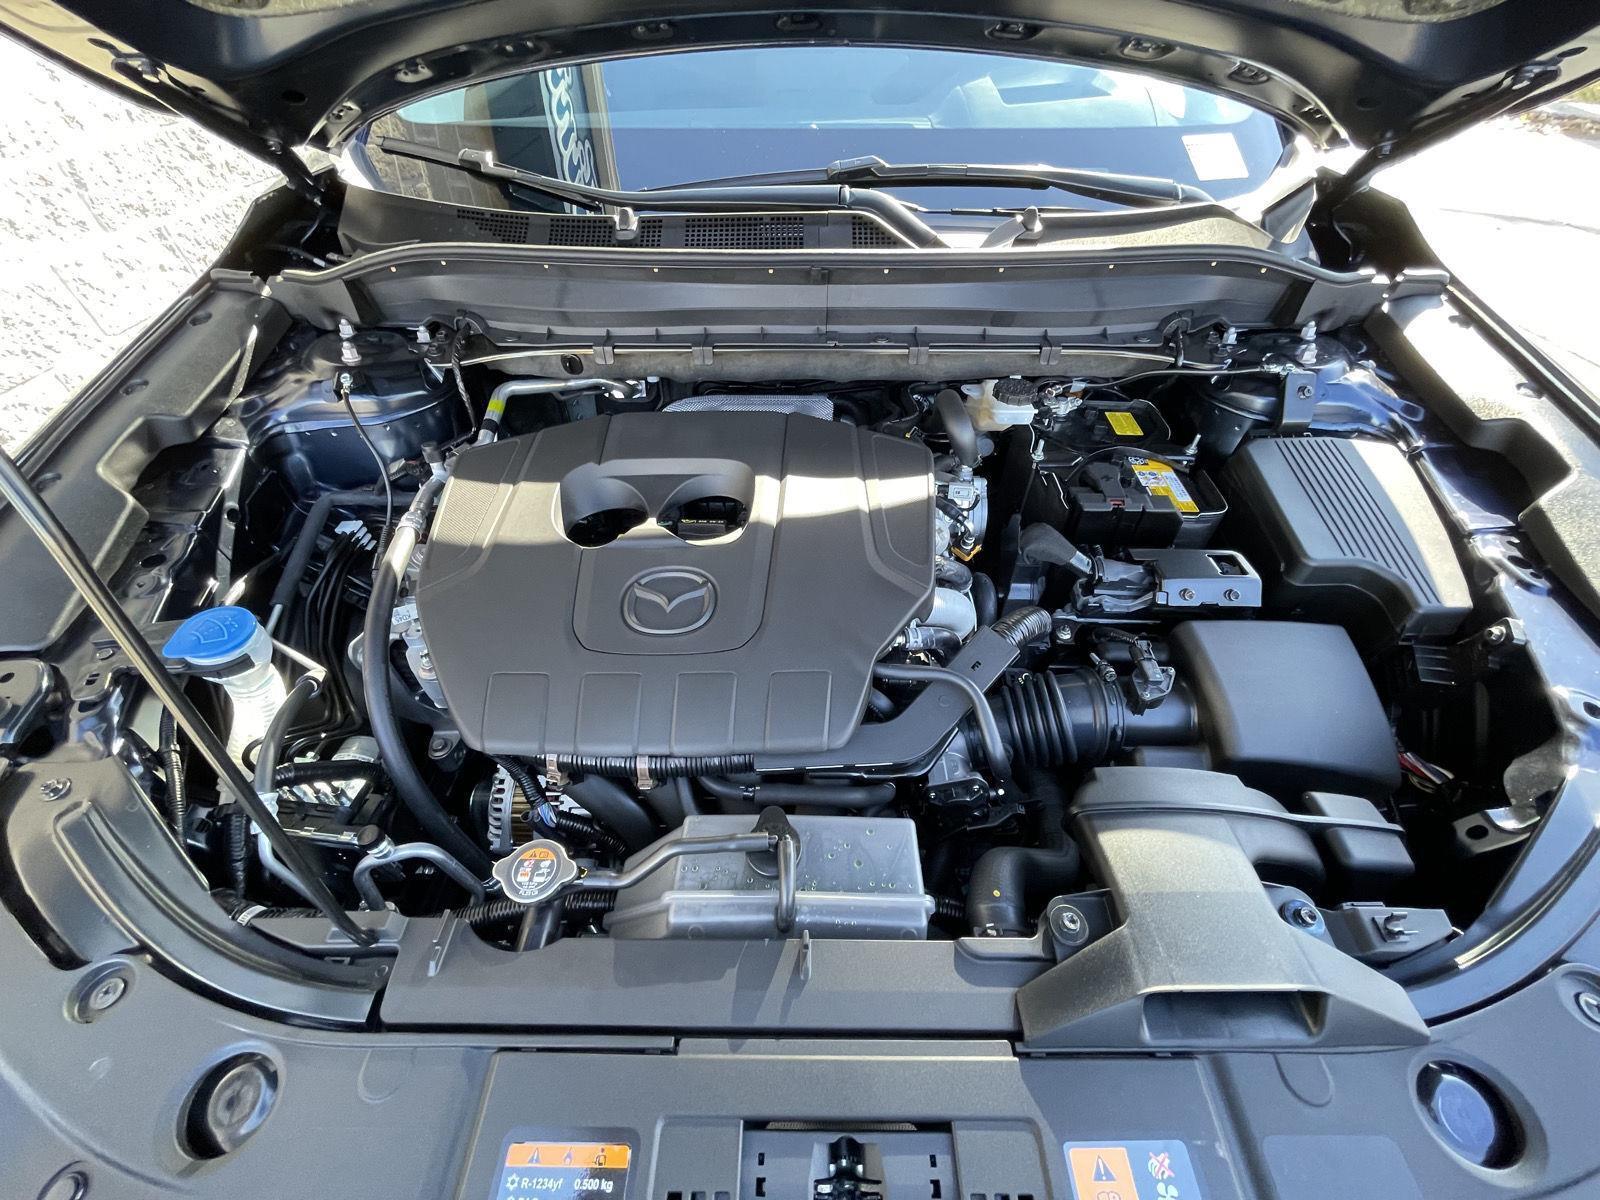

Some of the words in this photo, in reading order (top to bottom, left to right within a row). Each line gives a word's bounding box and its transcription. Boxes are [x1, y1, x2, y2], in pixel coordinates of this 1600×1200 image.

[520, 1177, 563, 1192] R-1234yf
[574, 1178, 599, 1190] 0.500
[600, 1178, 614, 1193] kg
